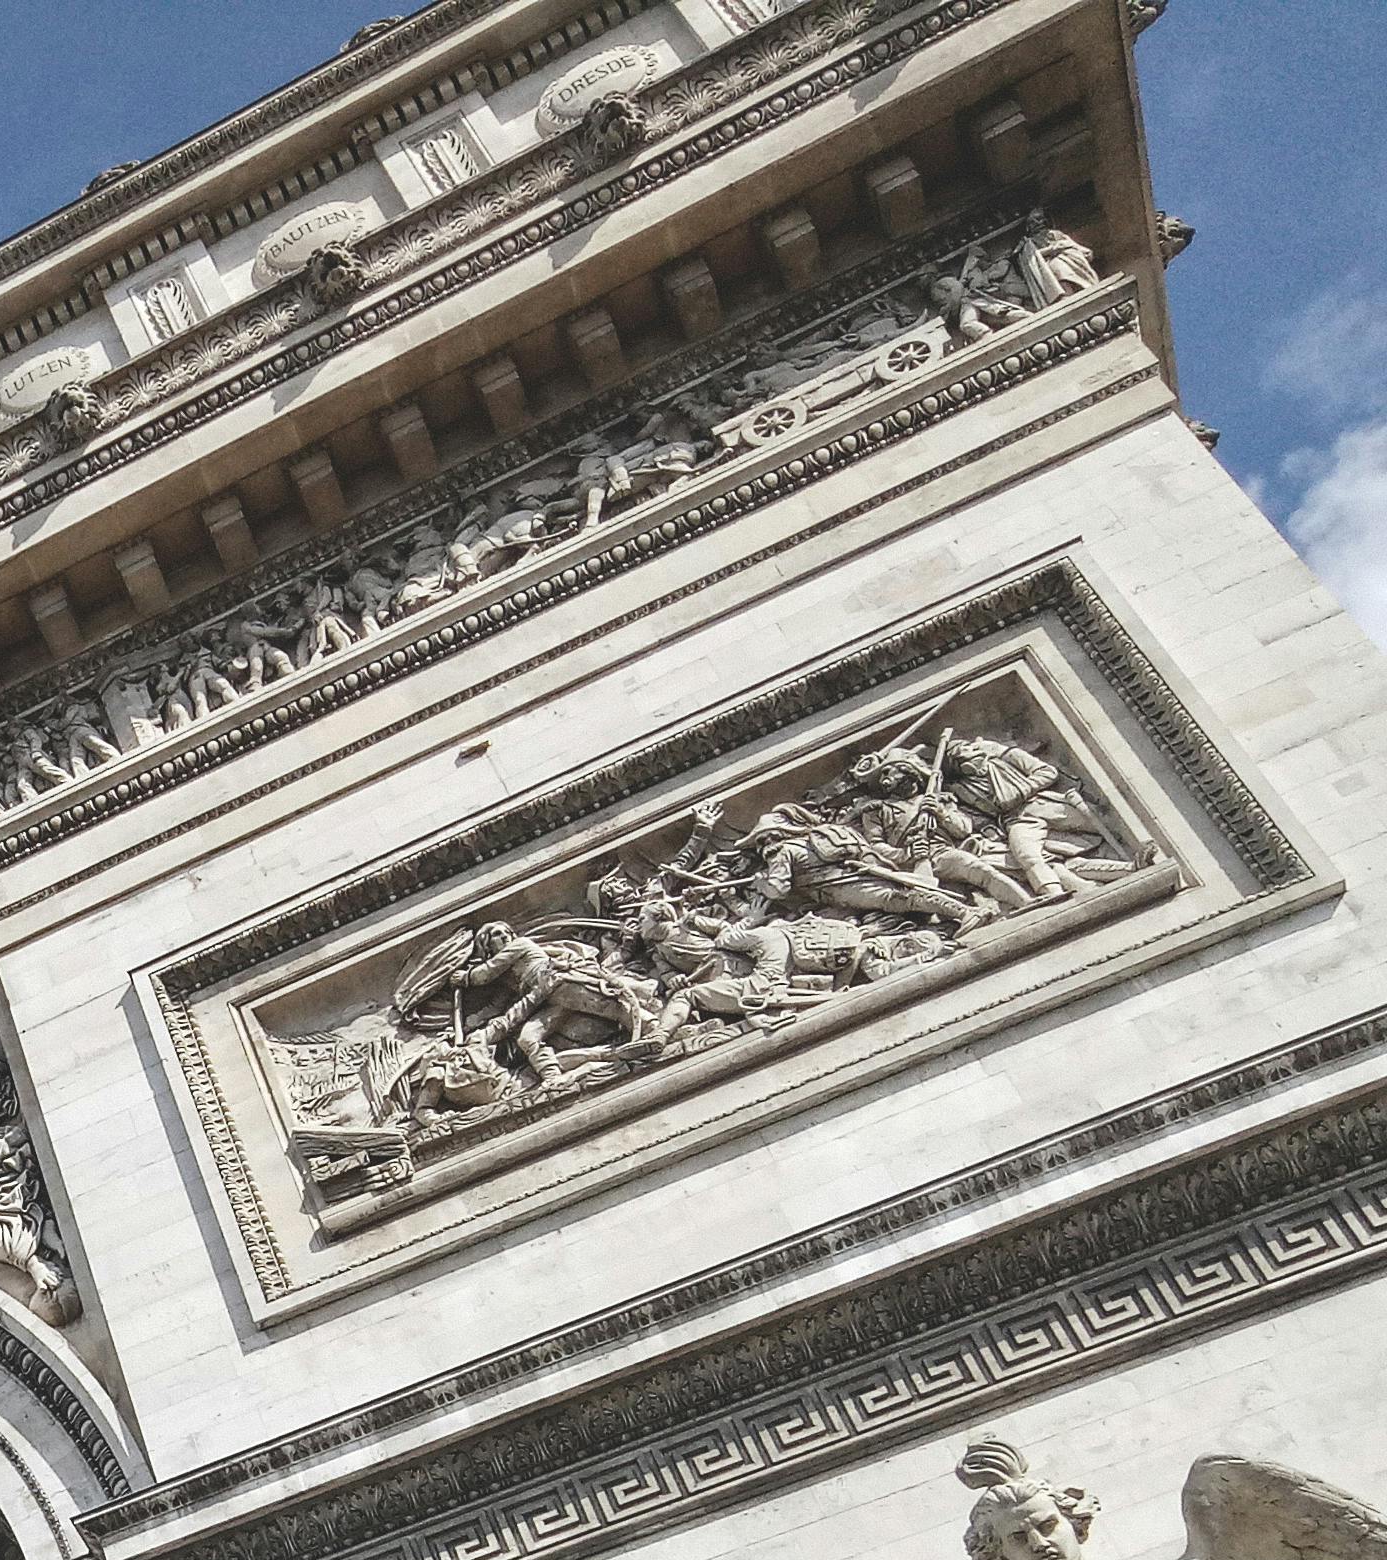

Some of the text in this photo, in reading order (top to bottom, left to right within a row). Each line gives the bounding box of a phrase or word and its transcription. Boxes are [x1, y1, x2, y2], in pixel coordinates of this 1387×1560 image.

[558, 55, 636, 102] DRESDE
[269, 210, 350, 258] BAUTZEN
[5, 356, 72, 399] LUTZEN
